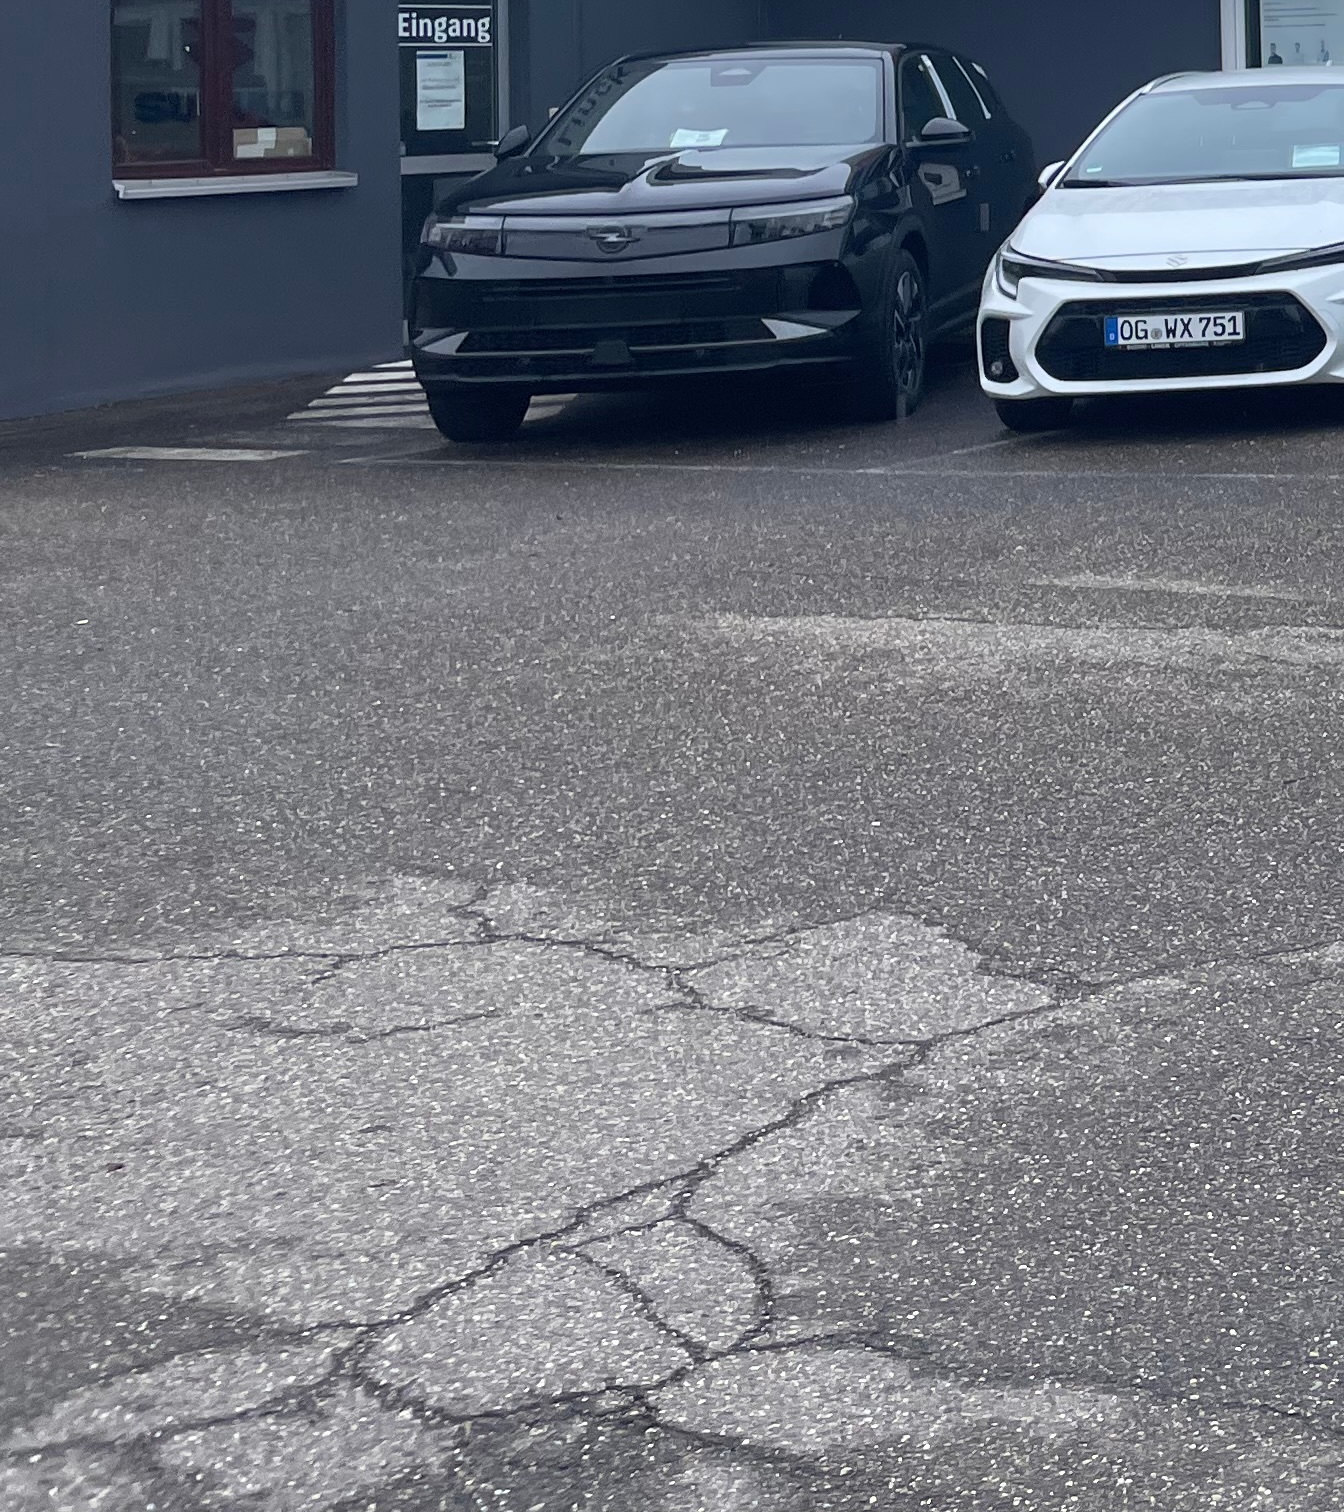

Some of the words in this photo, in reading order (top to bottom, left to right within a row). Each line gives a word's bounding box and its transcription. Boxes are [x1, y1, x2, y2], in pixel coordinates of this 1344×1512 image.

[398, 12, 491, 43] Eingang
[1120, 319, 1148, 341] OG
[1164, 317, 1193, 339] WX
[1199, 315, 1241, 337] 751
